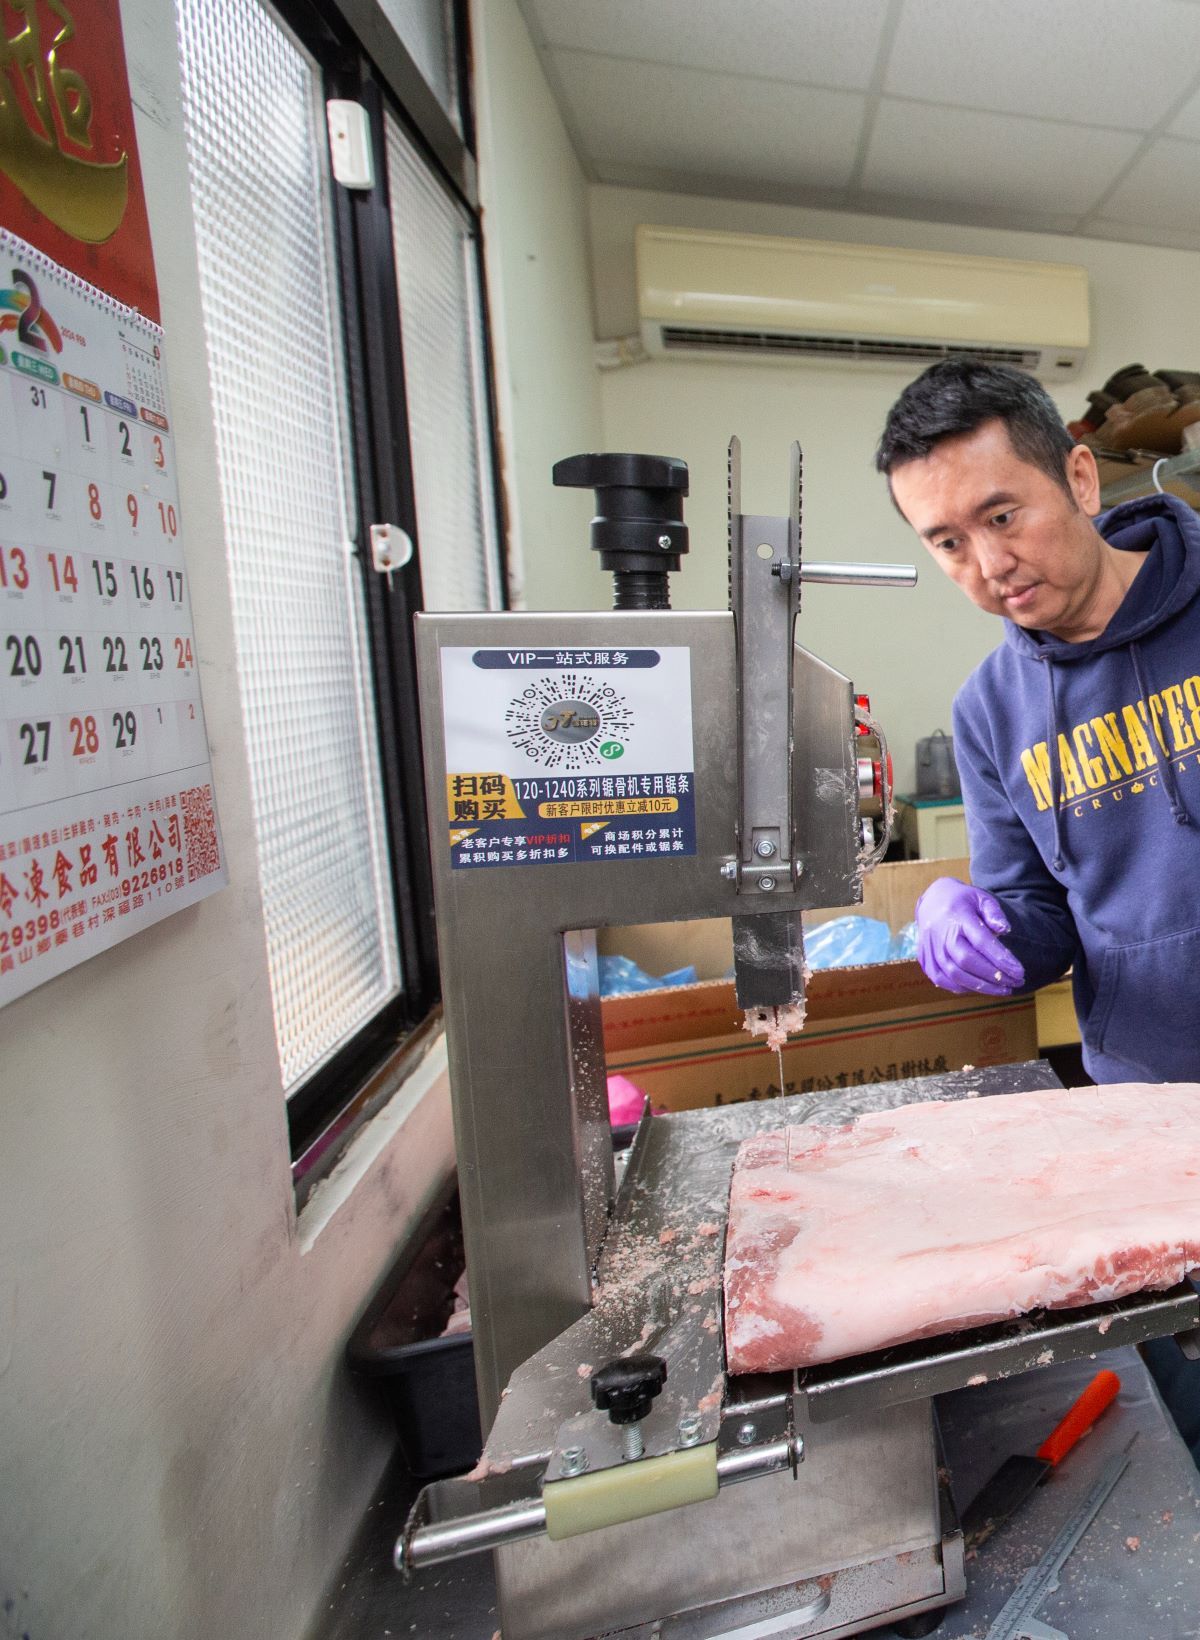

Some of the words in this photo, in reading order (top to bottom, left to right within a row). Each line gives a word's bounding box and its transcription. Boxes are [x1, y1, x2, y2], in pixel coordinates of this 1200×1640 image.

[30, 386, 47, 409] 31
[80, 406, 91, 442] 1
[119, 421, 132, 456] 2
[153, 435, 164, 468] 3
[42, 470, 57, 510] 7
[88, 483, 102, 520] 8
[127, 493, 138, 528] 9
[158, 502, 177, 537] 10
[0, 546, 29, 590] 13
[48, 553, 78, 593] 14
[92, 559, 117, 597] 15
[131, 565, 154, 601] 16
[166, 570, 183, 603] 17
[6, 635, 42, 677] 20
[59, 635, 87, 674] 21
[103, 636, 128, 672] 22
[140, 637, 163, 671] 23
[174, 637, 193, 669] 24
[507, 651, 630, 666] VIP一站式服务
[20, 721, 51, 765] 27
[70, 715, 99, 757] 28
[113, 711, 136, 749] 29
[157, 708, 163, 724] 1
[189, 704, 195, 720] 2
[452, 774, 506, 798] 扫码
[453, 798, 507, 821] 购买
[546, 799, 672, 817] 新客户限时优惠立减10元
[461, 833, 571, 849] 老客户专享VIP折扣
[604, 827, 684, 842] 商场积分累计
[459, 847, 569, 864] 累积购买多折扣多
[591, 840, 685, 856] 可换配件或锯条
